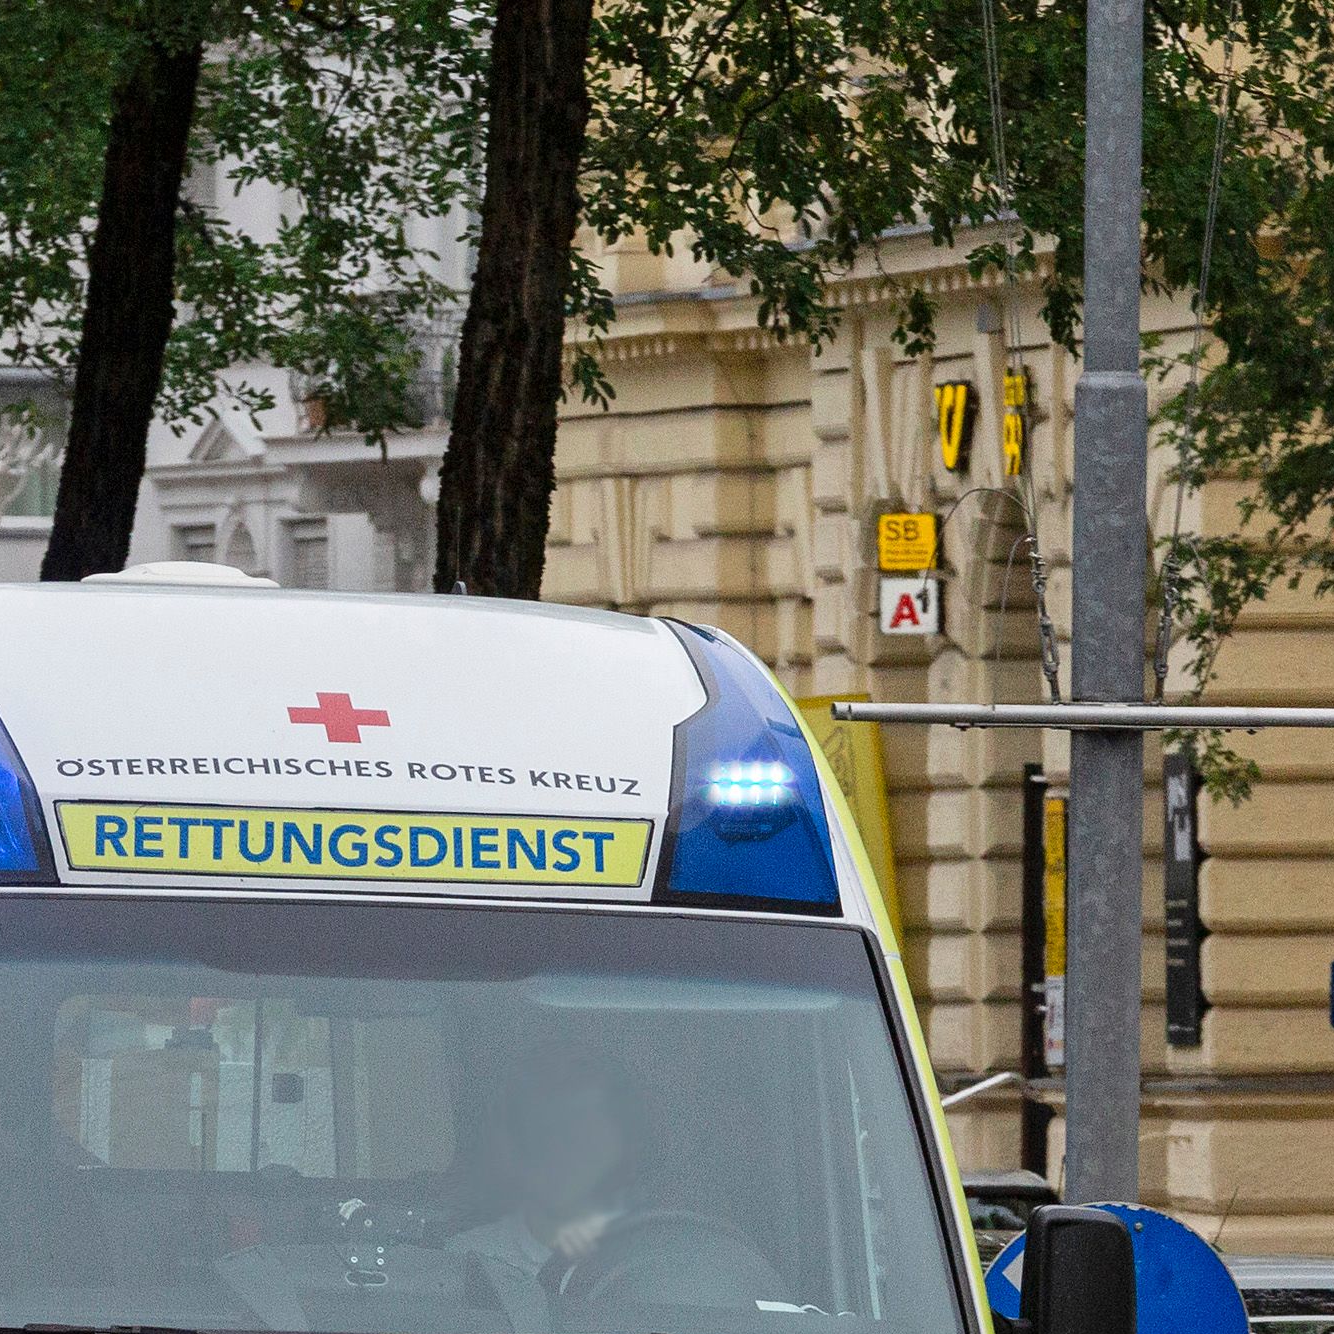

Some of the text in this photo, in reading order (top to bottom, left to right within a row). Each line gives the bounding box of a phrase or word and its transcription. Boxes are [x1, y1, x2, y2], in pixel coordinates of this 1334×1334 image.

[886, 519, 920, 541] SB
[56, 757, 641, 797] ÖSTERREICHISCHES ROTES KREUZ
[94, 814, 615, 873] RETTUNGSDIENST
